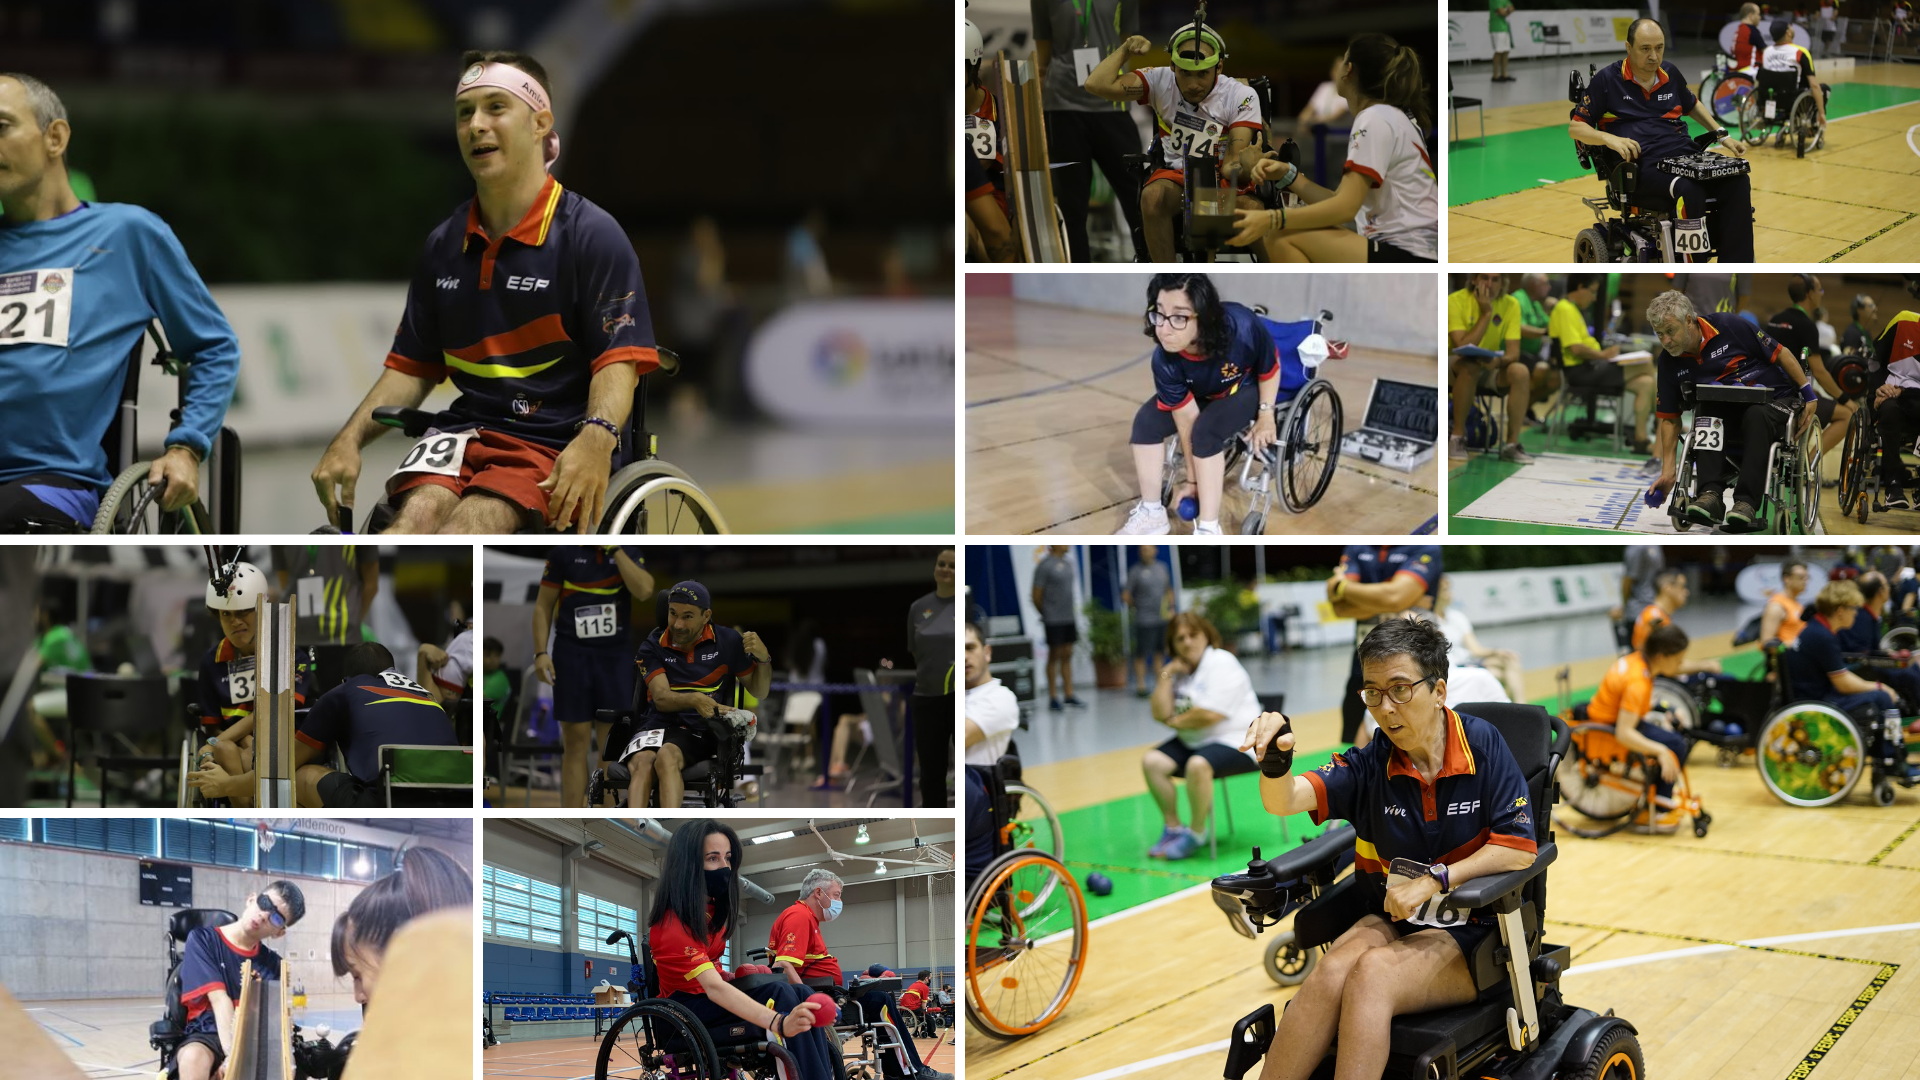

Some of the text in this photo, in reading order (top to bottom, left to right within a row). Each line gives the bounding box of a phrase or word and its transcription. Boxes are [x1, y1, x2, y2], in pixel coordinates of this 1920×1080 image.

[1657, 92, 1674, 101] ESP
[1171, 128, 1212, 157] 314
[1671, 166, 1696, 179] BOCCIA
[1711, 166, 1740, 178] BOCCIA
[1676, 231, 1709, 252] 408
[506, 275, 550, 292] ESP
[0, 299, 56, 339] 21
[1710, 343, 1729, 359] ESP
[1695, 429, 1720, 449] 23
[398, 437, 458, 470] 09
[579, 617, 614, 636] 115
[701, 651, 719, 661] ESP
[624, 735, 659, 755] 115
[1446, 799, 1481, 816] ESP
[1787, 1060, 1817, 1080] FEDPC
[1812, 1032, 1841, 1053] FEDPC
[1836, 1007, 1863, 1026] FEDPC
